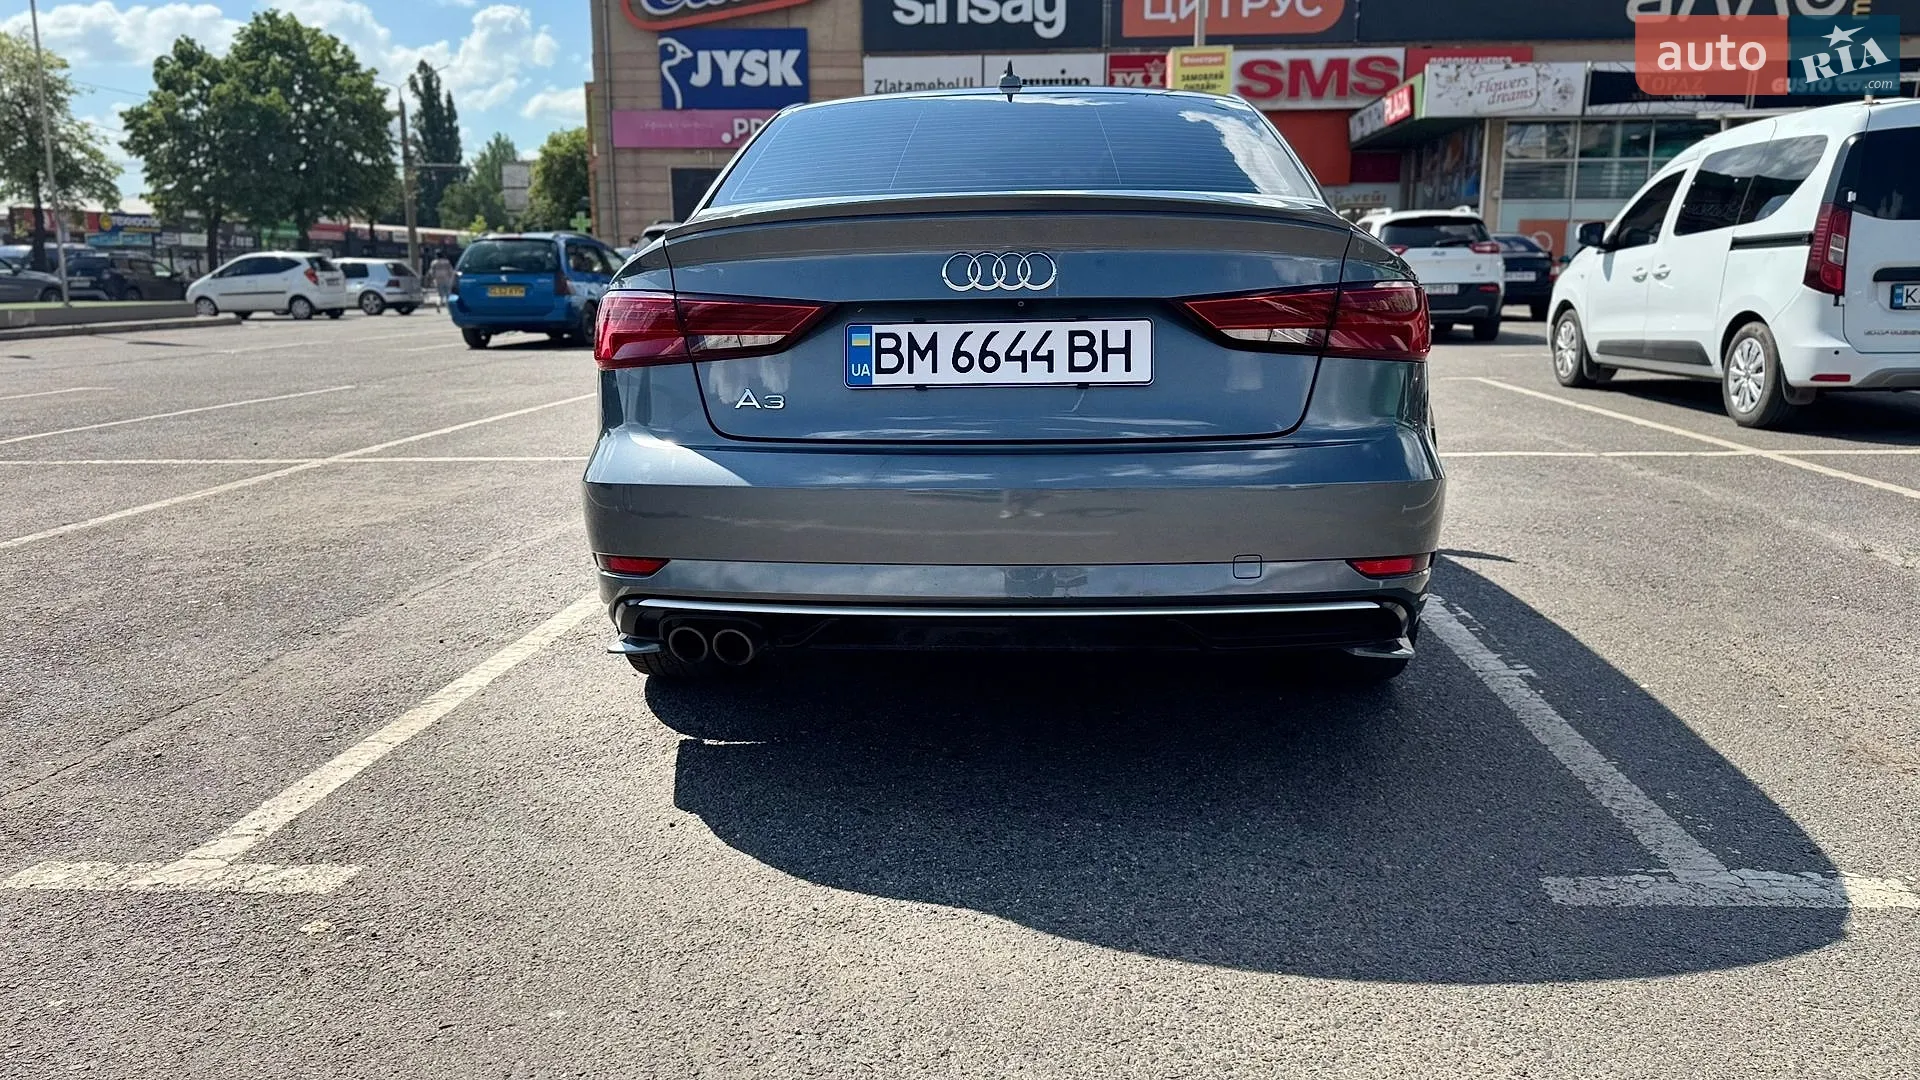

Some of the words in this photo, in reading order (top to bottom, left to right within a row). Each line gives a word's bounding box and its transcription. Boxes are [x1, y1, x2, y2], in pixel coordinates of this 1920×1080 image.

[689, 50, 803, 87] JYSK
[1238, 55, 1400, 99] SMS
[1475, 76, 1528, 94] Flowers
[1487, 89, 1534, 105] dreams
[874, 331, 938, 375] BM
[951, 330, 1055, 373] 6644
[1067, 329, 1132, 373] BH
[851, 363, 871, 377] UA
[734, 388, 785, 409] A3
